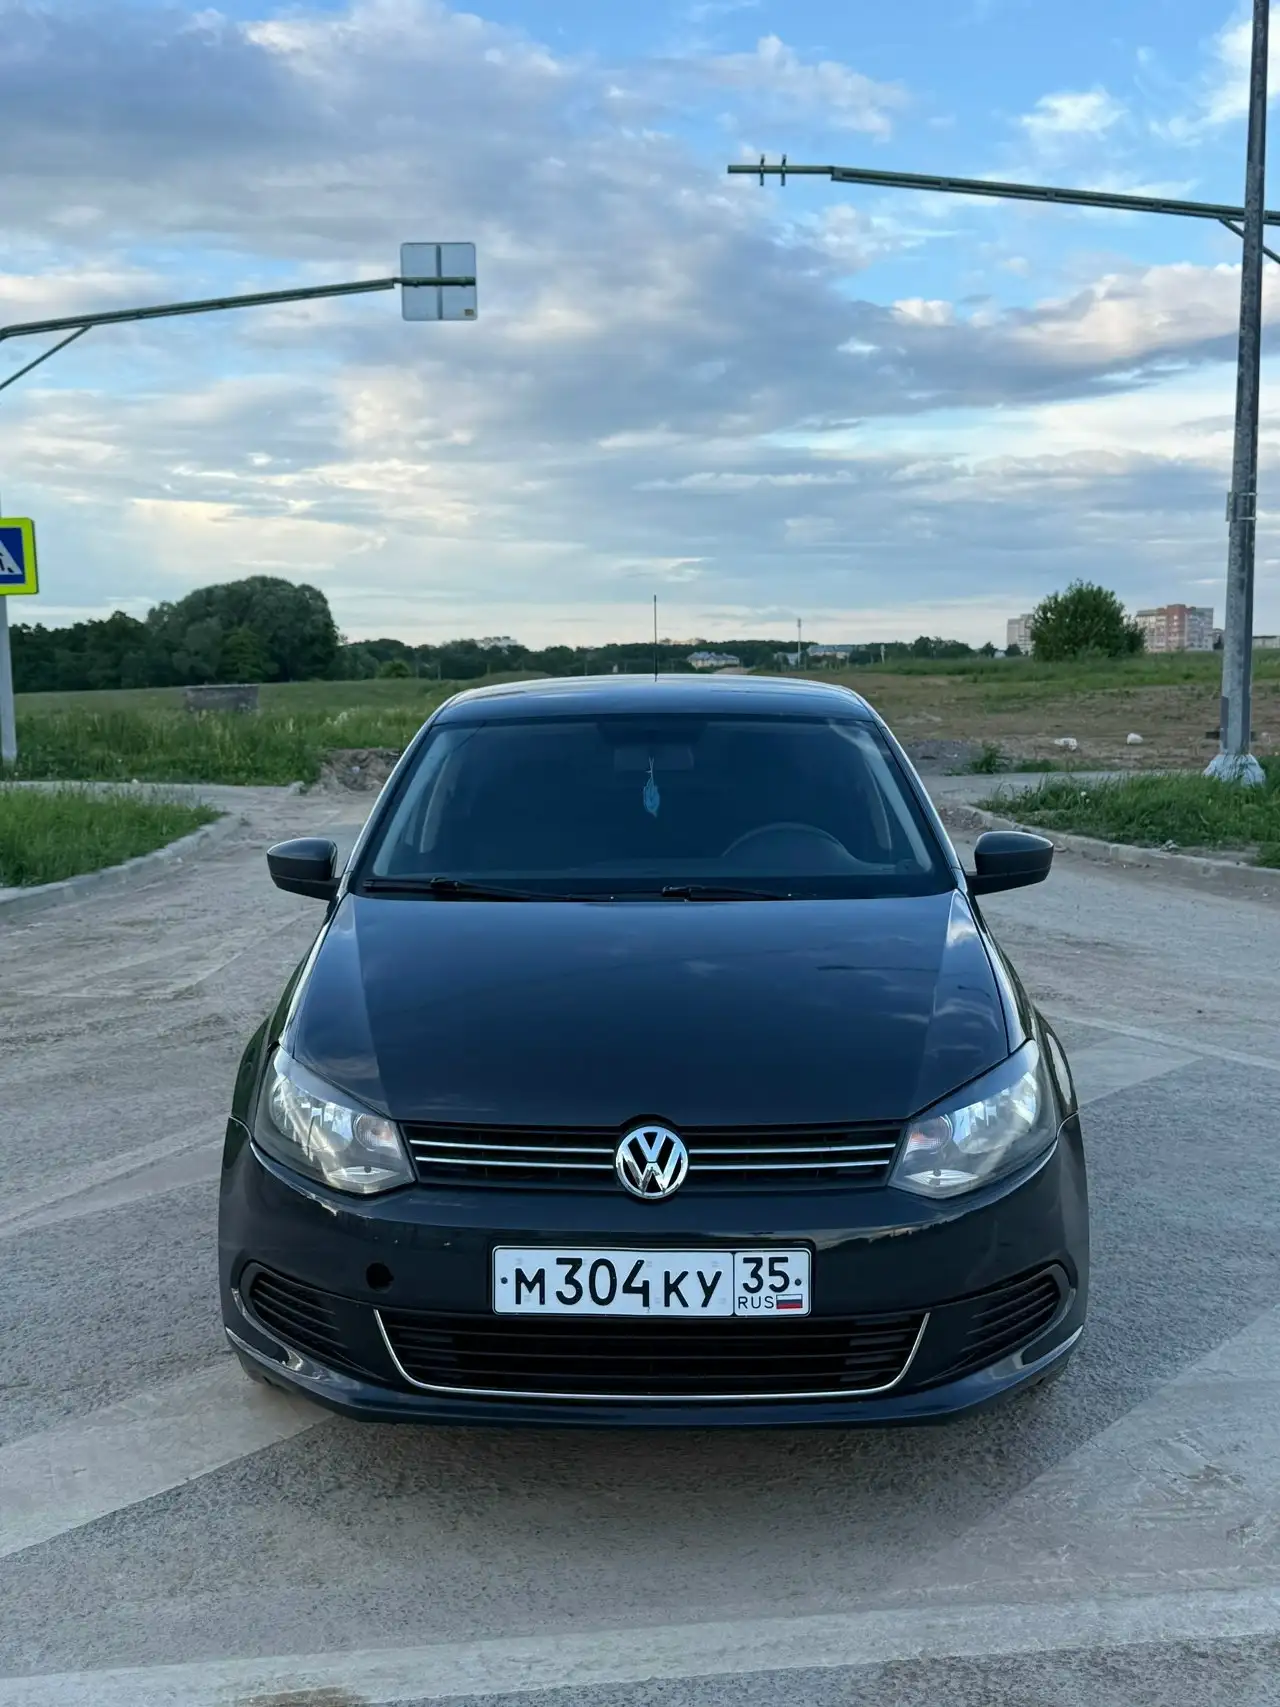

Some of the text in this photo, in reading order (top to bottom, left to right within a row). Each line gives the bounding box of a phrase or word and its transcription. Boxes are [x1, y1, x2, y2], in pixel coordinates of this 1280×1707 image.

[616, 1126, 688, 1199] VW
[742, 1256, 790, 1293] 35
[738, 1296, 775, 1309] RUS
